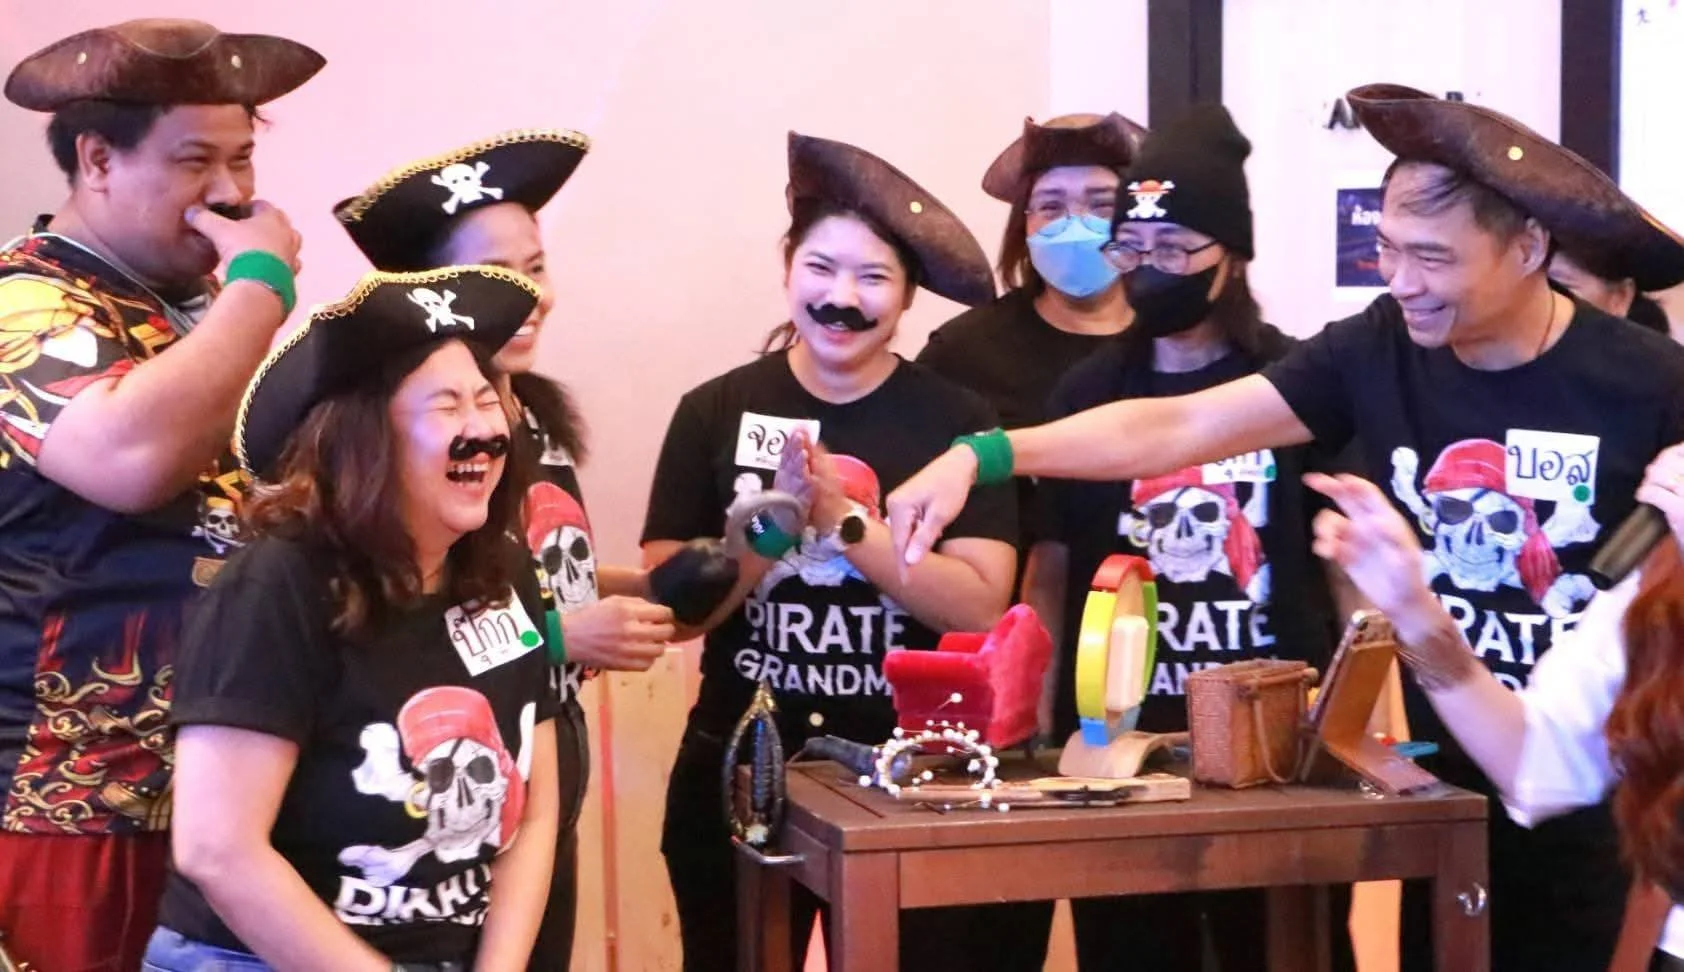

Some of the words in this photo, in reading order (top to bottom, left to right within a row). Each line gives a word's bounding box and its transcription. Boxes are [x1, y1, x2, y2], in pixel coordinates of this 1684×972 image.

[1507, 445, 1595, 486] บอส
[745, 597, 912, 654] PIRATE
[1157, 599, 1276, 652] RATE
[1440, 594, 1584, 666] RAT
[734, 649, 892, 697] GRANDM
